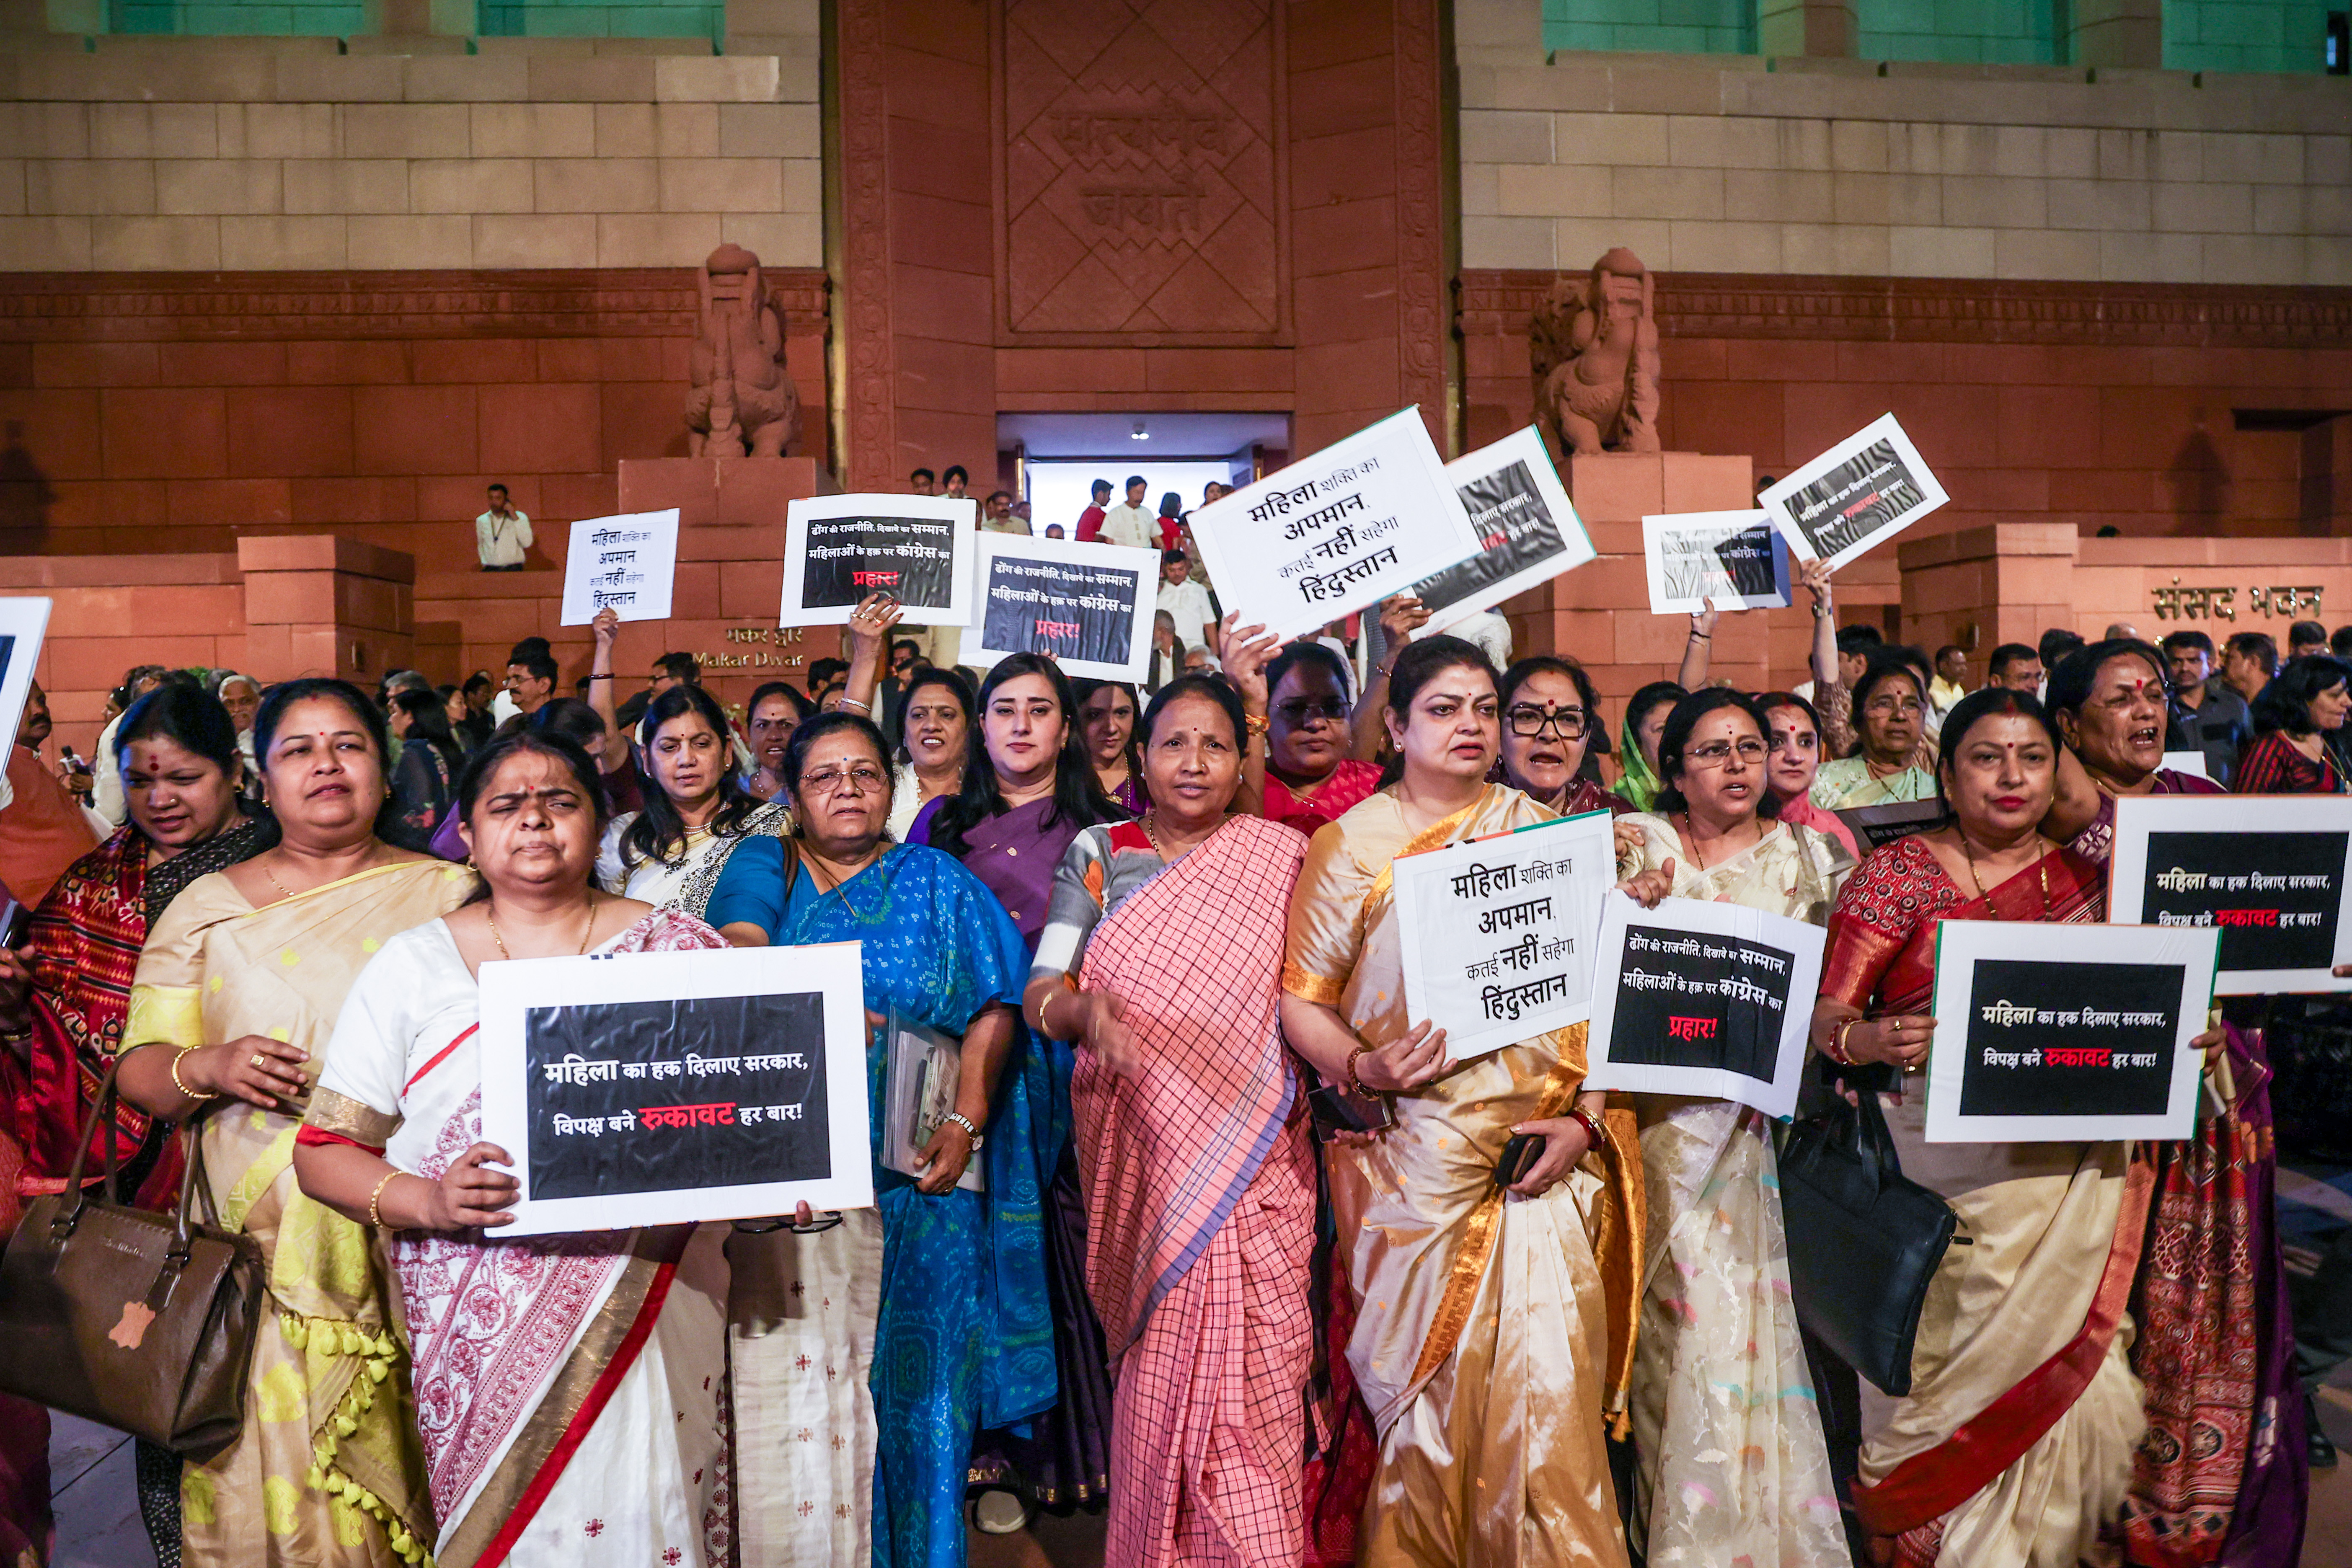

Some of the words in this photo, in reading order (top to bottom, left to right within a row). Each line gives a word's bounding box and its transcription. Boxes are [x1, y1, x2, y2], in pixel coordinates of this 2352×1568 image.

[1247, 480, 1318, 524] महिला
[1319, 467, 1358, 492] शक्ति
[1359, 456, 1380, 475] का
[592, 529, 622, 546] महिला
[811, 524, 827, 536] ढोंग
[839, 520, 875, 533] राजनीति,
[877, 523, 899, 533] दिखावे
[910, 524, 949, 536] सम्मान,
[809, 543, 855, 560] महिलाओं
[856, 546, 865, 555] के
[883, 548, 894, 556] पर
[895, 542, 938, 559] कांग्रेस
[938, 551, 951, 560] का
[1277, 550, 1317, 579] कतई
[1312, 524, 1357, 561] नहीं
[1358, 516, 1400, 540] सहेगा
[605, 568, 625, 585] नहीं
[853, 571, 898, 587] प्रहार!
[995, 561, 1013, 575] ढोंग
[1014, 566, 1024, 576] की
[1024, 566, 1060, 580] राजनीति,
[1062, 570, 1084, 581] दिखावे
[1086, 574, 1094, 583] का
[1096, 573, 1133, 588] सम्मान,
[1300, 545, 1399, 603] हिंदुस्तान
[991, 584, 1039, 603] महिलाओं
[1041, 592, 1049, 604] के
[1066, 598, 1078, 607] पर
[1079, 593, 1120, 612] कांग्रेस
[1120, 603, 1132, 613] का
[2151, 576, 2237, 623] संसद
[2249, 585, 2324, 618] भवन
[726, 628, 768, 643] मकर
[774, 628, 803, 648] द्वार
[1036, 620, 1080, 639] प्रहार!
[693, 652, 750, 667] Makar
[755, 652, 803, 667] Dwar
[1451, 863, 1517, 899] महिला
[1520, 860, 1553, 885] शक्ति
[1555, 858, 1572, 875] का
[2157, 866, 2208, 893] महिला
[2208, 876, 2225, 890] का
[2228, 876, 2249, 892] हक
[2251, 871, 2287, 891] दिलाए
[2288, 875, 2331, 890] सरकार,
[2215, 909, 2280, 927] रुकावट
[2279, 913, 2296, 929] हर
[2297, 912, 2322, 927] बार!
[1465, 952, 1499, 980] कतई
[1500, 933, 1539, 971] नहीं
[1542, 937, 1574, 960] सहेगा
[1629, 933, 1649, 951] ढोंग
[1650, 940, 1660, 952] की
[1662, 938, 1701, 957] राजनीति,
[1703, 943, 1727, 959] दिखावे
[1739, 948, 1786, 976] सम्मान,
[1481, 974, 1567, 1020] हिंदुस्तान
[1623, 967, 1676, 992] महिलाओं
[1677, 976, 1687, 991] के
[1688, 982, 1704, 995] हक़
[1705, 983, 1718, 995] पर
[1719, 975, 1768, 1006] कांग्रेस
[1768, 995, 1783, 1012] का
[1982, 999, 2037, 1028] महिला
[2037, 1010, 2056, 1024] का
[2057, 1012, 2078, 1027] हक
[2081, 1006, 2120, 1028] दिलाए
[2121, 1012, 2167, 1029] सरकार,
[1669, 1016, 1718, 1041] प्रहार!
[543, 1053, 620, 1087] महिला
[622, 1061, 647, 1079] का
[649, 1060, 681, 1080] हक
[685, 1052, 742, 1077] दिलाए
[743, 1051, 809, 1073] सरकार,
[1983, 1046, 2020, 1070] विपक्ष
[2021, 1048, 2042, 1068] बने
[2044, 1047, 2112, 1068] रुकावट
[2112, 1052, 2129, 1069] हर
[2130, 1052, 2157, 1068] बार!
[553, 1112, 604, 1138] विपक्ष
[608, 1109, 636, 1132] बने
[638, 1101, 737, 1131] रुकावट
[738, 1106, 763, 1127] हर
[765, 1103, 804, 1123] बार!
